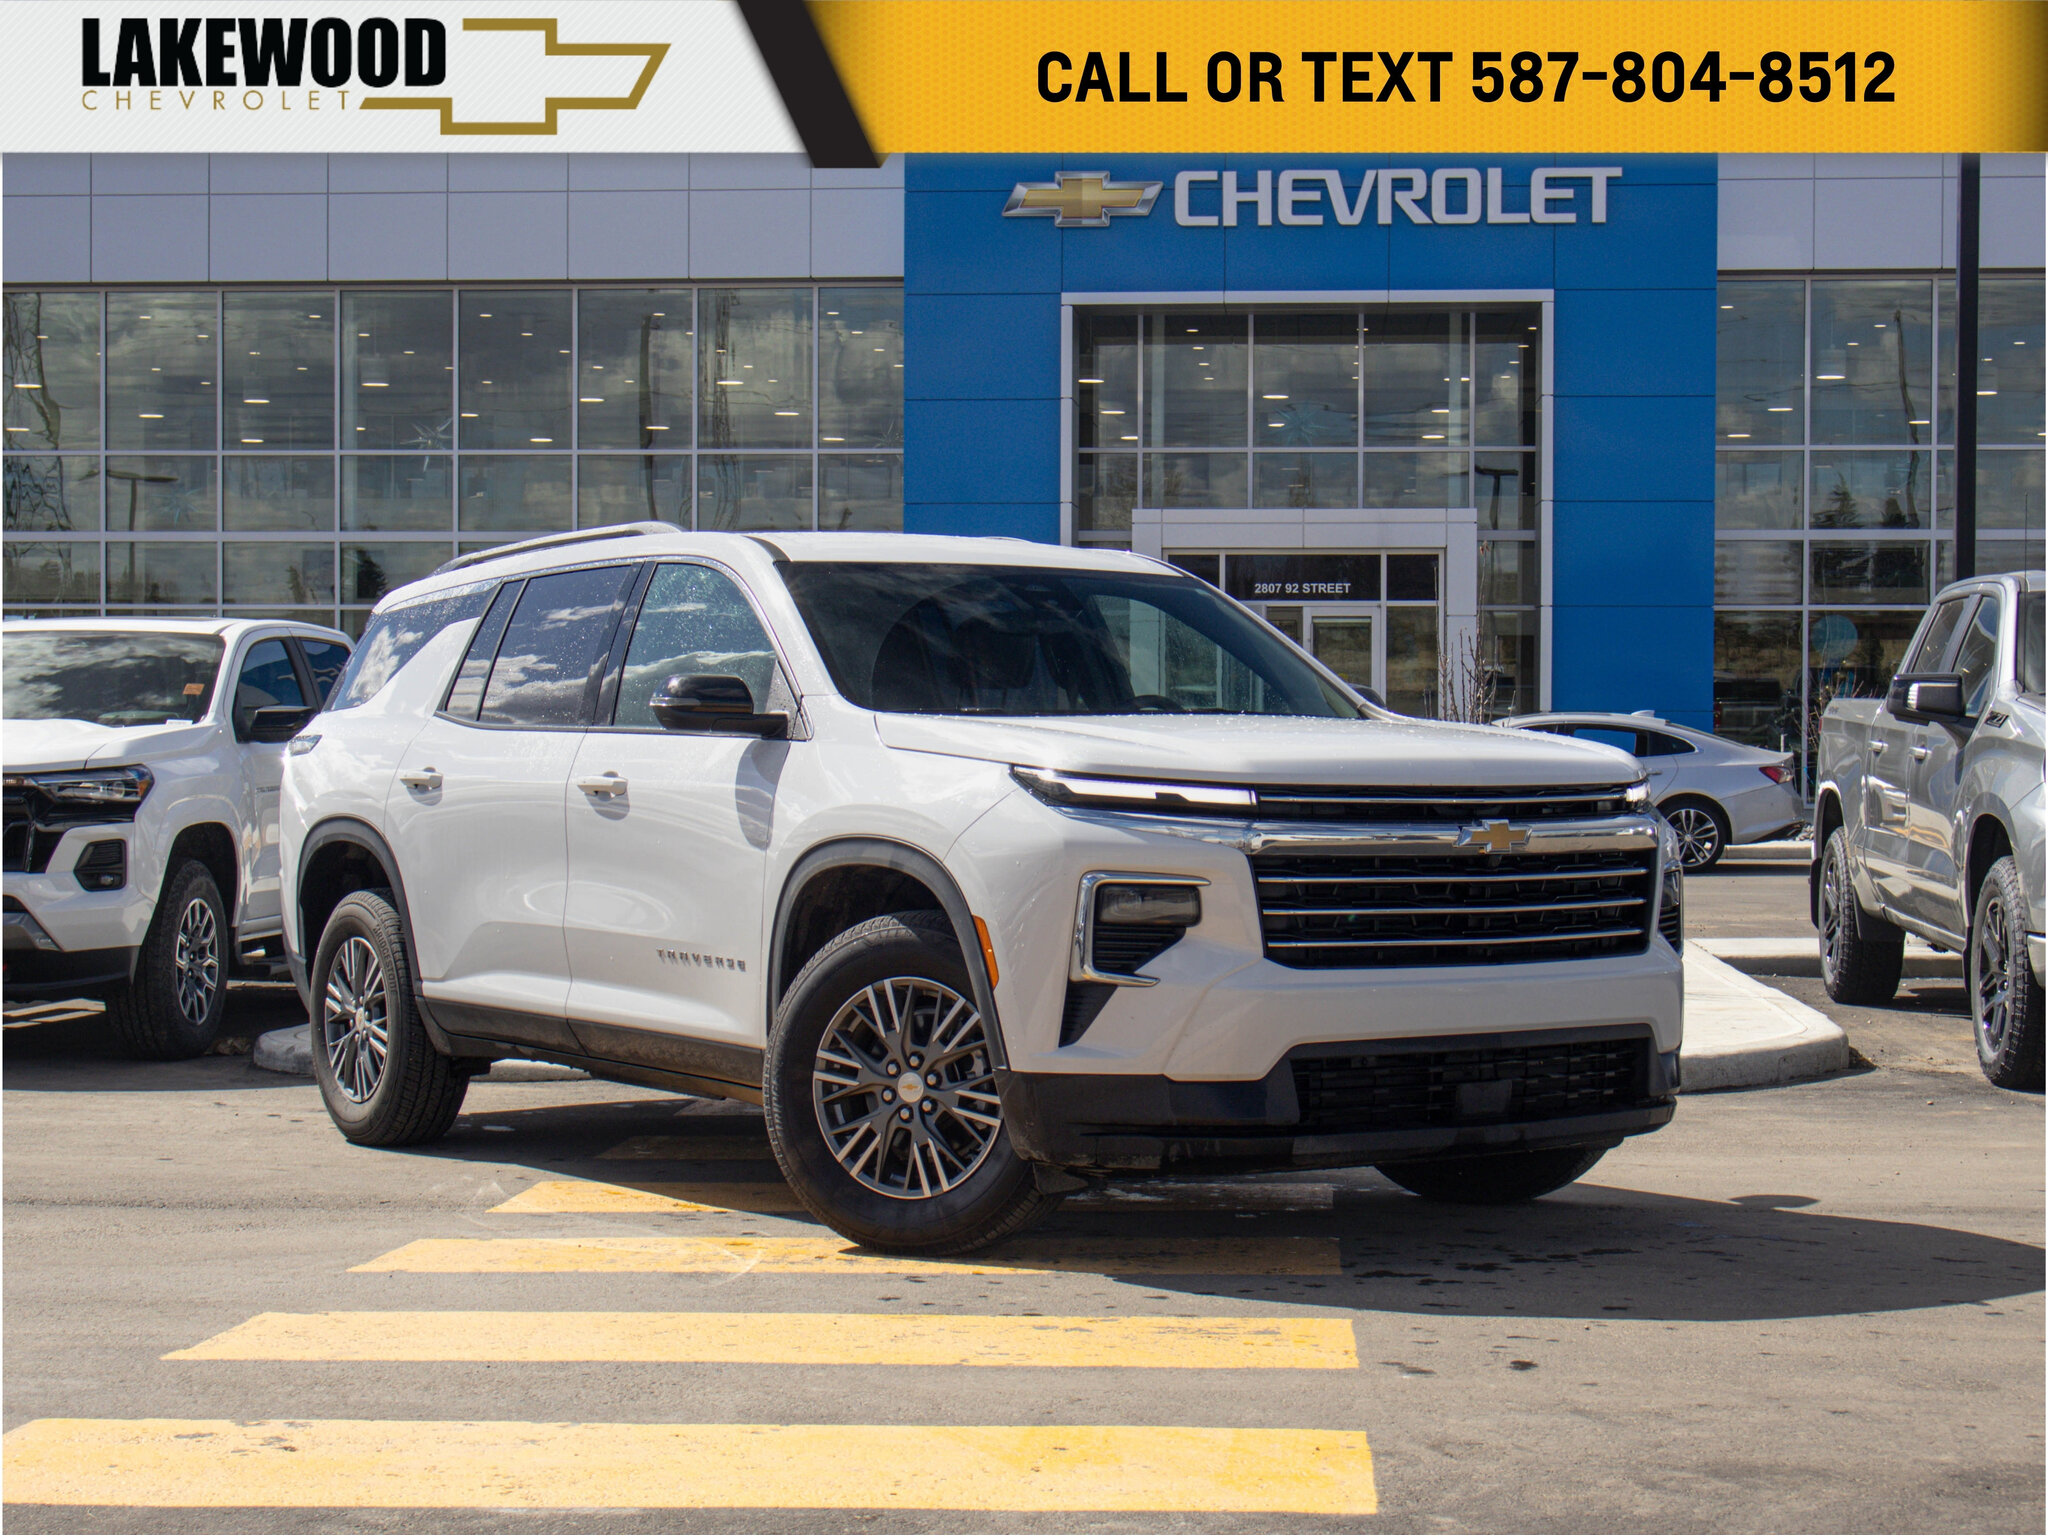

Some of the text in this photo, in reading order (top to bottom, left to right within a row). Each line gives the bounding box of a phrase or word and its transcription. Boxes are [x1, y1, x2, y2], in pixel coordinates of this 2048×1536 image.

[1174, 167, 1623, 228] CHEVROLET
[1254, 583, 1351, 594] 2807 92 STREET
